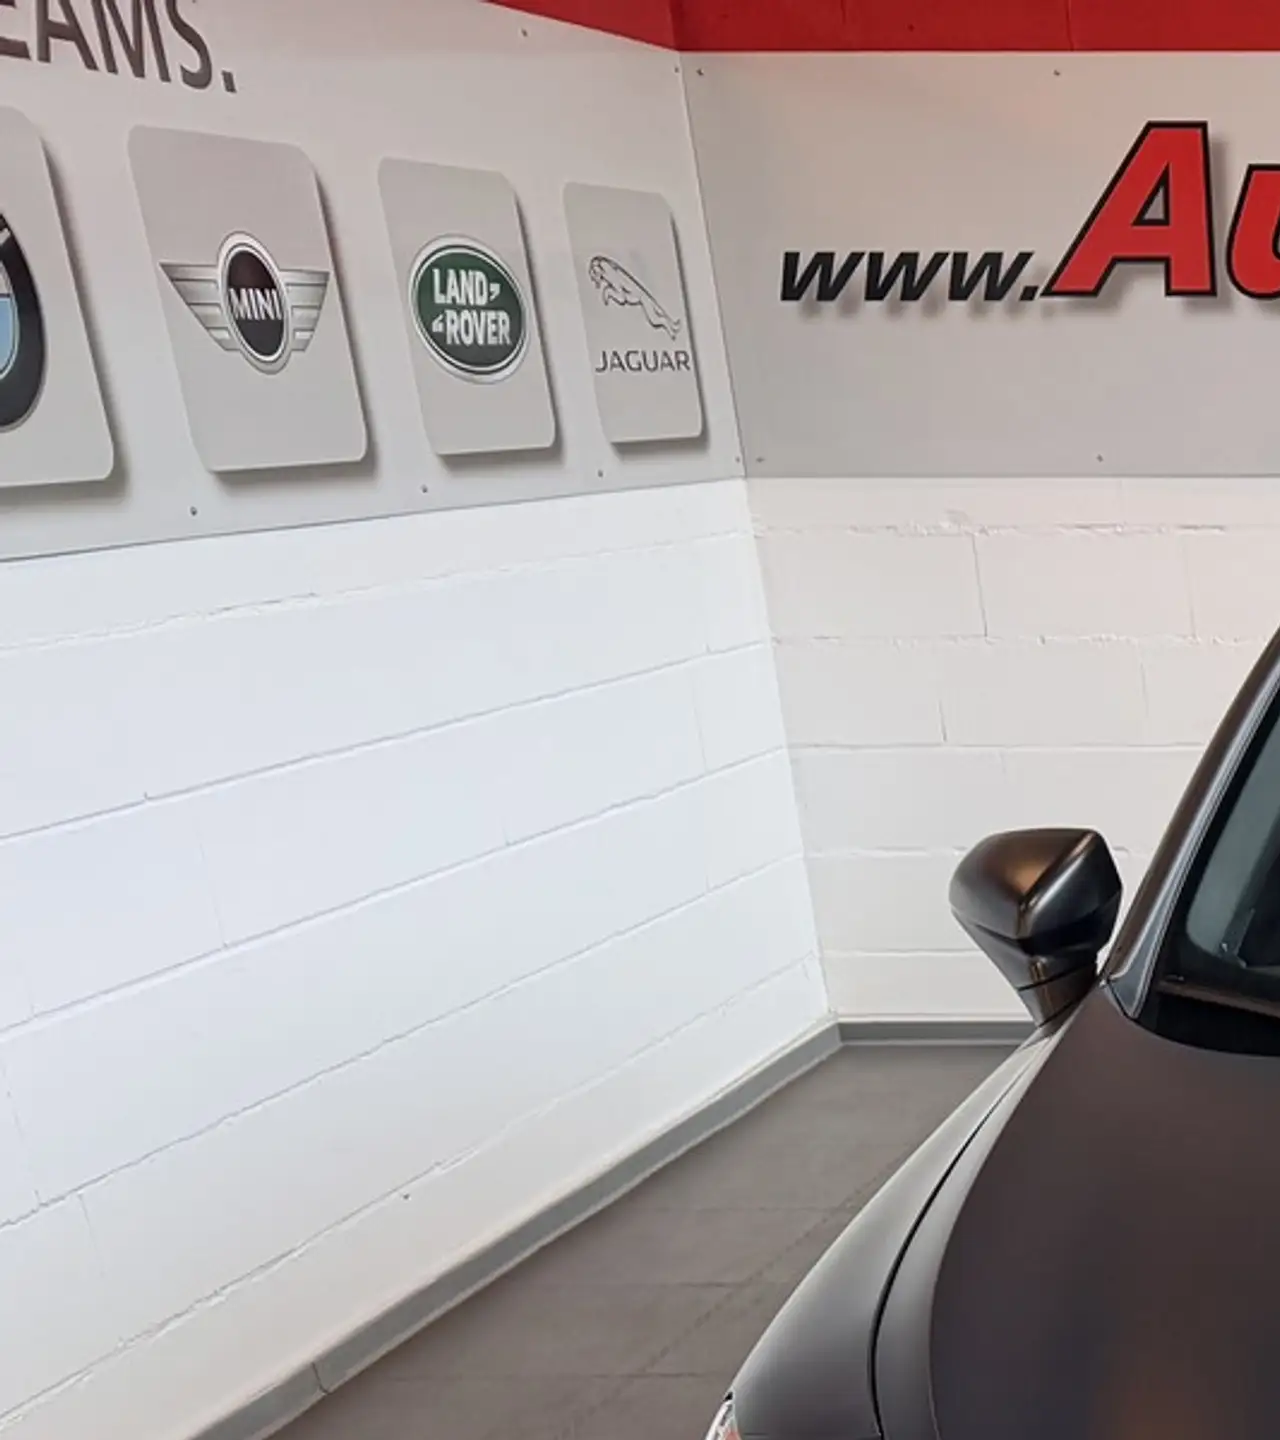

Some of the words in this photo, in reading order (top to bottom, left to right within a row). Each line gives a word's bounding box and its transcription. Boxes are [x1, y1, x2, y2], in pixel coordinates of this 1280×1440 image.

[227, 286, 283, 321] MINI
[432, 268, 490, 306] LAND
[445, 308, 511, 346] ROVER
[594, 350, 692, 373] JAGUAR
